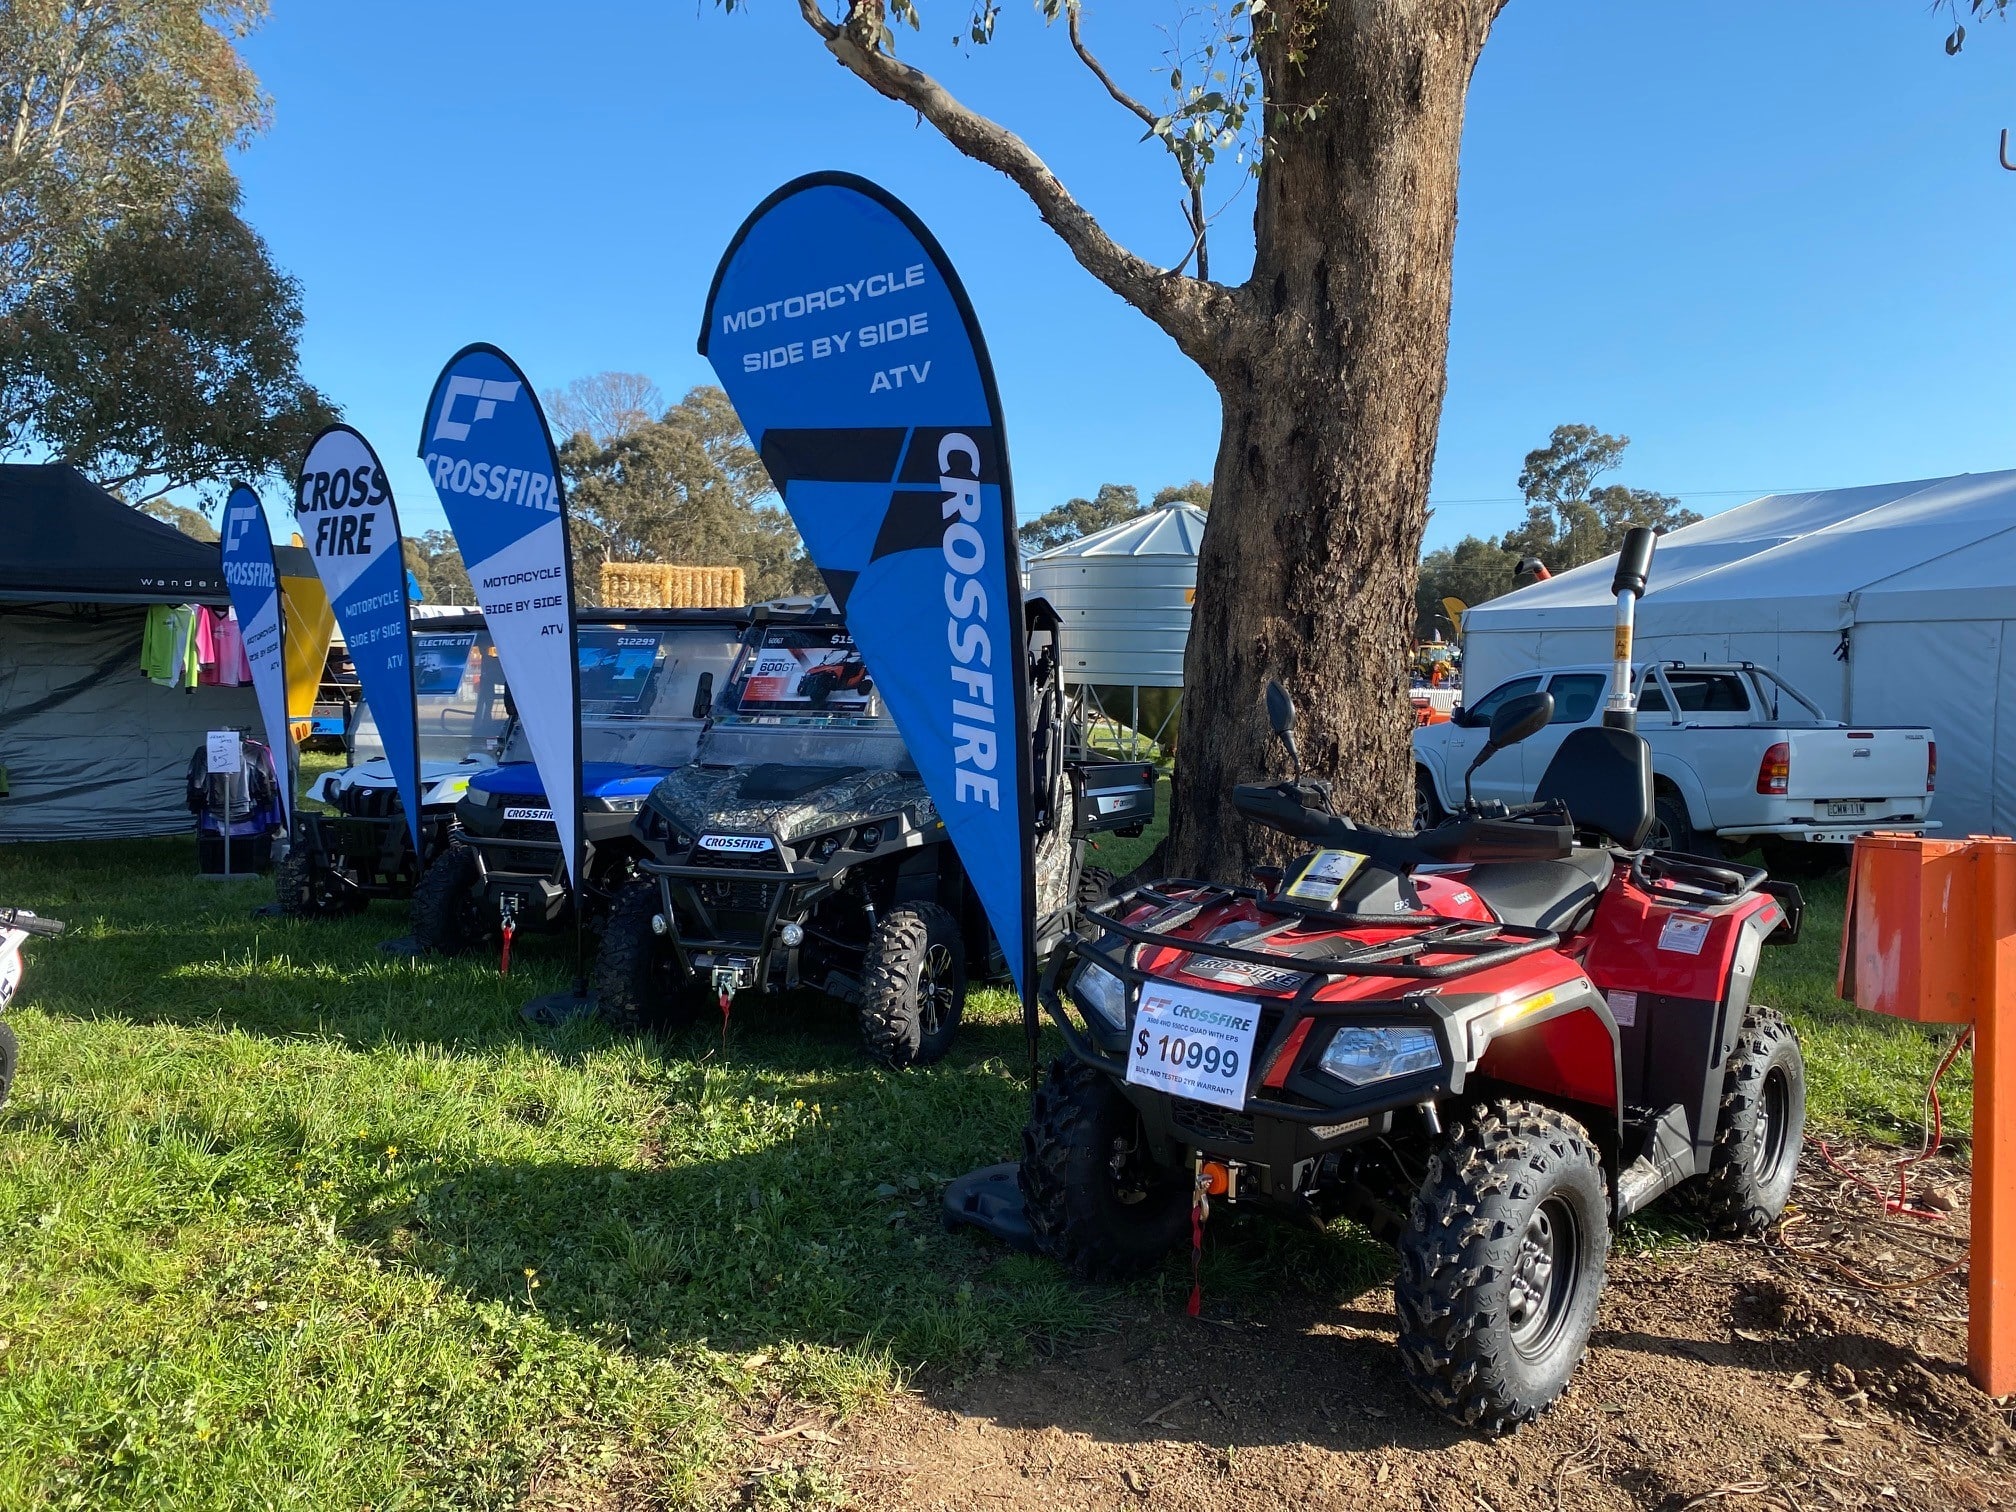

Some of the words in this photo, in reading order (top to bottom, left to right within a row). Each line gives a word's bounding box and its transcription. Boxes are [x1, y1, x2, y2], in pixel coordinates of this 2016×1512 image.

[722, 263, 925, 334] MOTORCYCLE
[743, 342, 804, 372] SIDE
[811, 331, 852, 359] BY
[858, 312, 929, 348] SIDE
[869, 360, 931, 394] ATV
[297, 465, 389, 513] CROSS
[425, 452, 560, 513] CROSSFIRE
[316, 512, 375, 557] FIRE
[222, 561, 275, 588] CROSSFIRE
[483, 566, 561, 588] MOTORCYCLE
[345, 589, 399, 619] MOTORCYCLE
[485, 602, 513, 615] SIDE
[516, 599, 531, 612] BY
[533, 595, 562, 609] SIDE
[350, 630, 369, 648] SIDE
[370, 626, 381, 642] BY
[382, 621, 401, 639] SIDE
[541, 623, 564, 636] ATV
[938, 432, 999, 811] CROSSFIRE
[418, 639, 456, 647] ELECTRIC
[616, 637, 656, 647] $12299
[830, 634, 854, 645] $15
[387, 654, 403, 670] ATV
[759, 662, 797, 672] 600GT
[507, 809, 554, 820] CROSSFIR
[705, 837, 766, 849] CROSSFIRE
[1394, 898, 1410, 911] EPS
[1190, 959, 1302, 987] CROSSFIRE
[1173, 1004, 1252, 1032] CROSSFIRE
[1189, 1026, 1208, 1036] QUAD
[1208, 1030, 1225, 1040] WITH
[1225, 1034, 1239, 1043] EPS
[1136, 1028, 1151, 1059] $
[1158, 1034, 1239, 1078] 10999
[1135, 1065, 1150, 1075] BUILT
[1149, 1070, 1161, 1079] AND
[1161, 1072, 1183, 1084] TESTED
[1183, 1078, 1196, 1087] 2YR
[1196, 1081, 1235, 1096] WARRANTY
